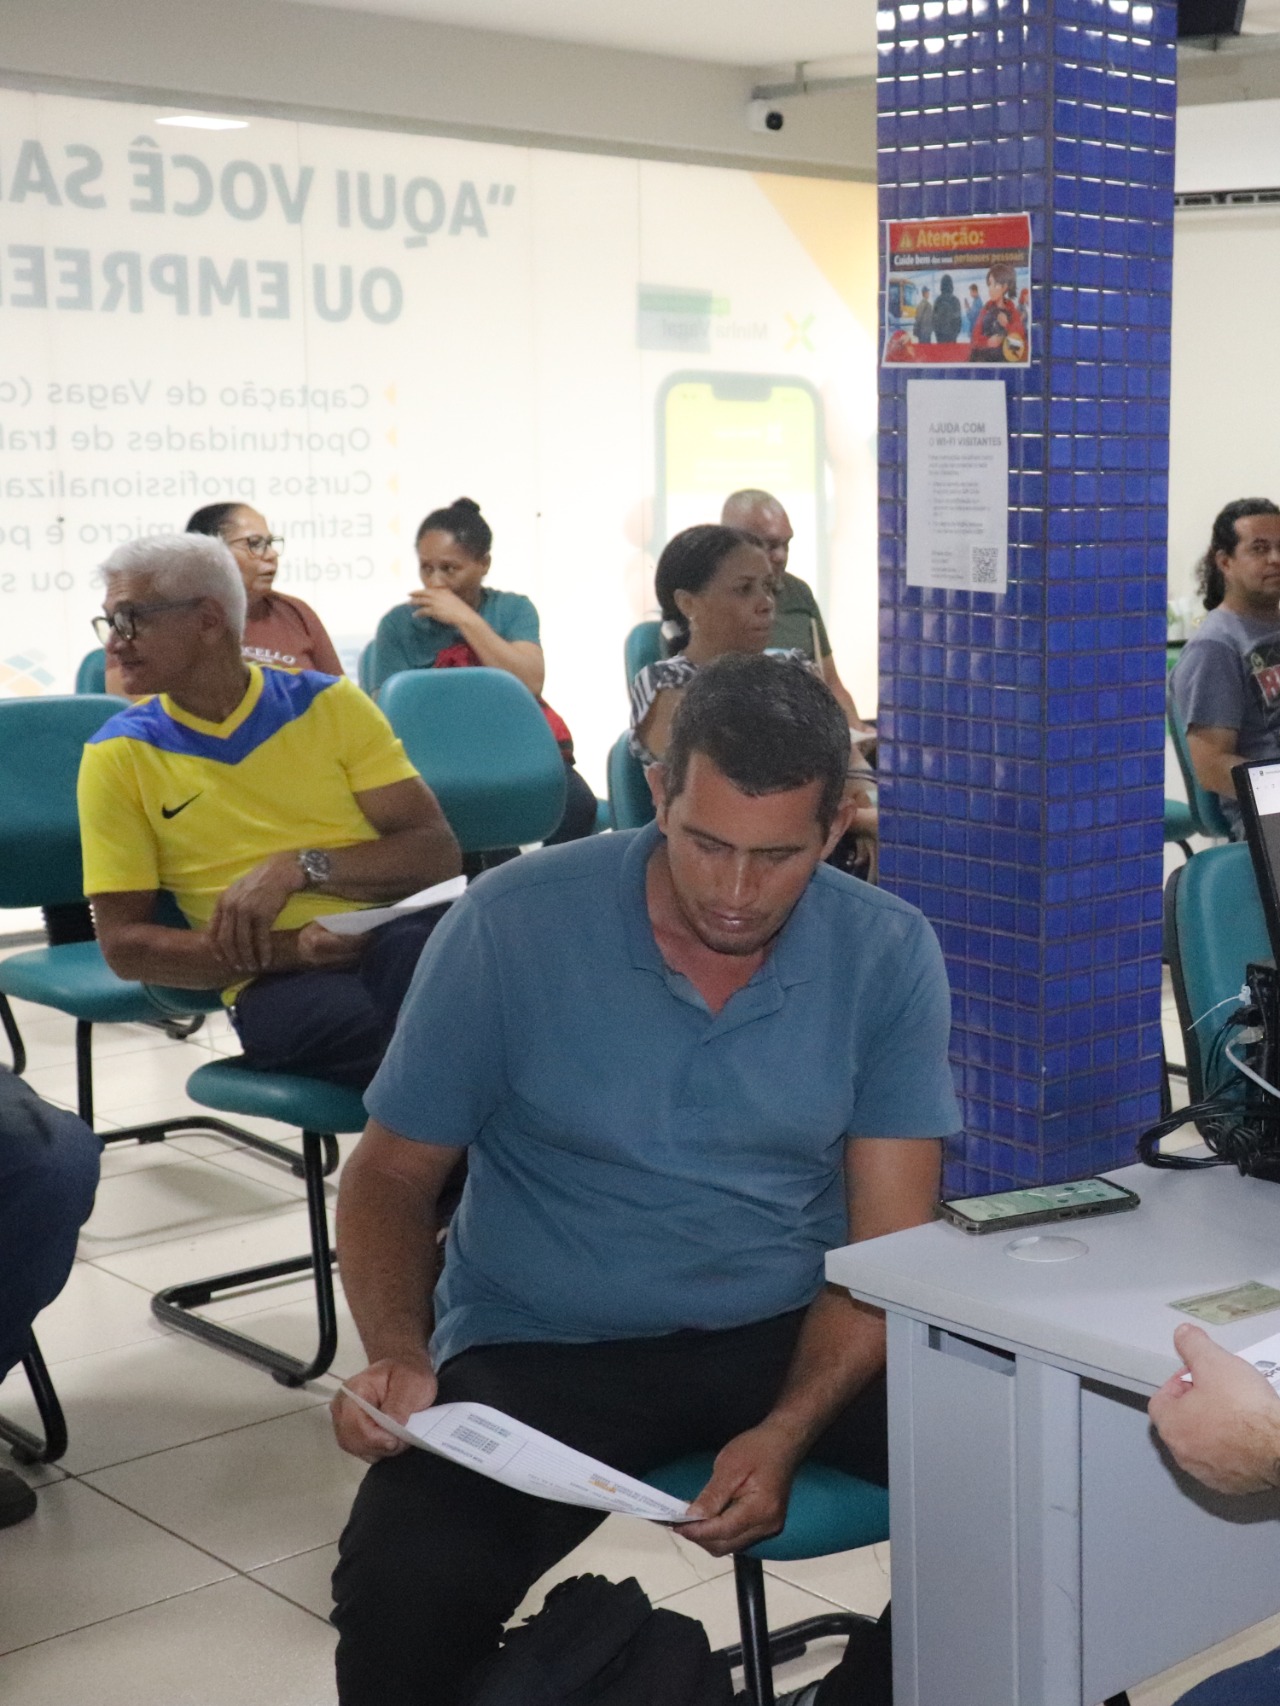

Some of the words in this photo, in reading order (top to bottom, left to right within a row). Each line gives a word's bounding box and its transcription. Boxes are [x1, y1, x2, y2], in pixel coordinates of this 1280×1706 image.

[916, 227, 984, 249] Atenção:
[894, 255, 914, 266] Cuide
[915, 254, 930, 265] bem
[929, 422, 959, 433] AJUDA
[963, 422, 985, 433] COM
[958, 437, 1002, 446] VISITANTES
[242, 646, 297, 664] CELLO
